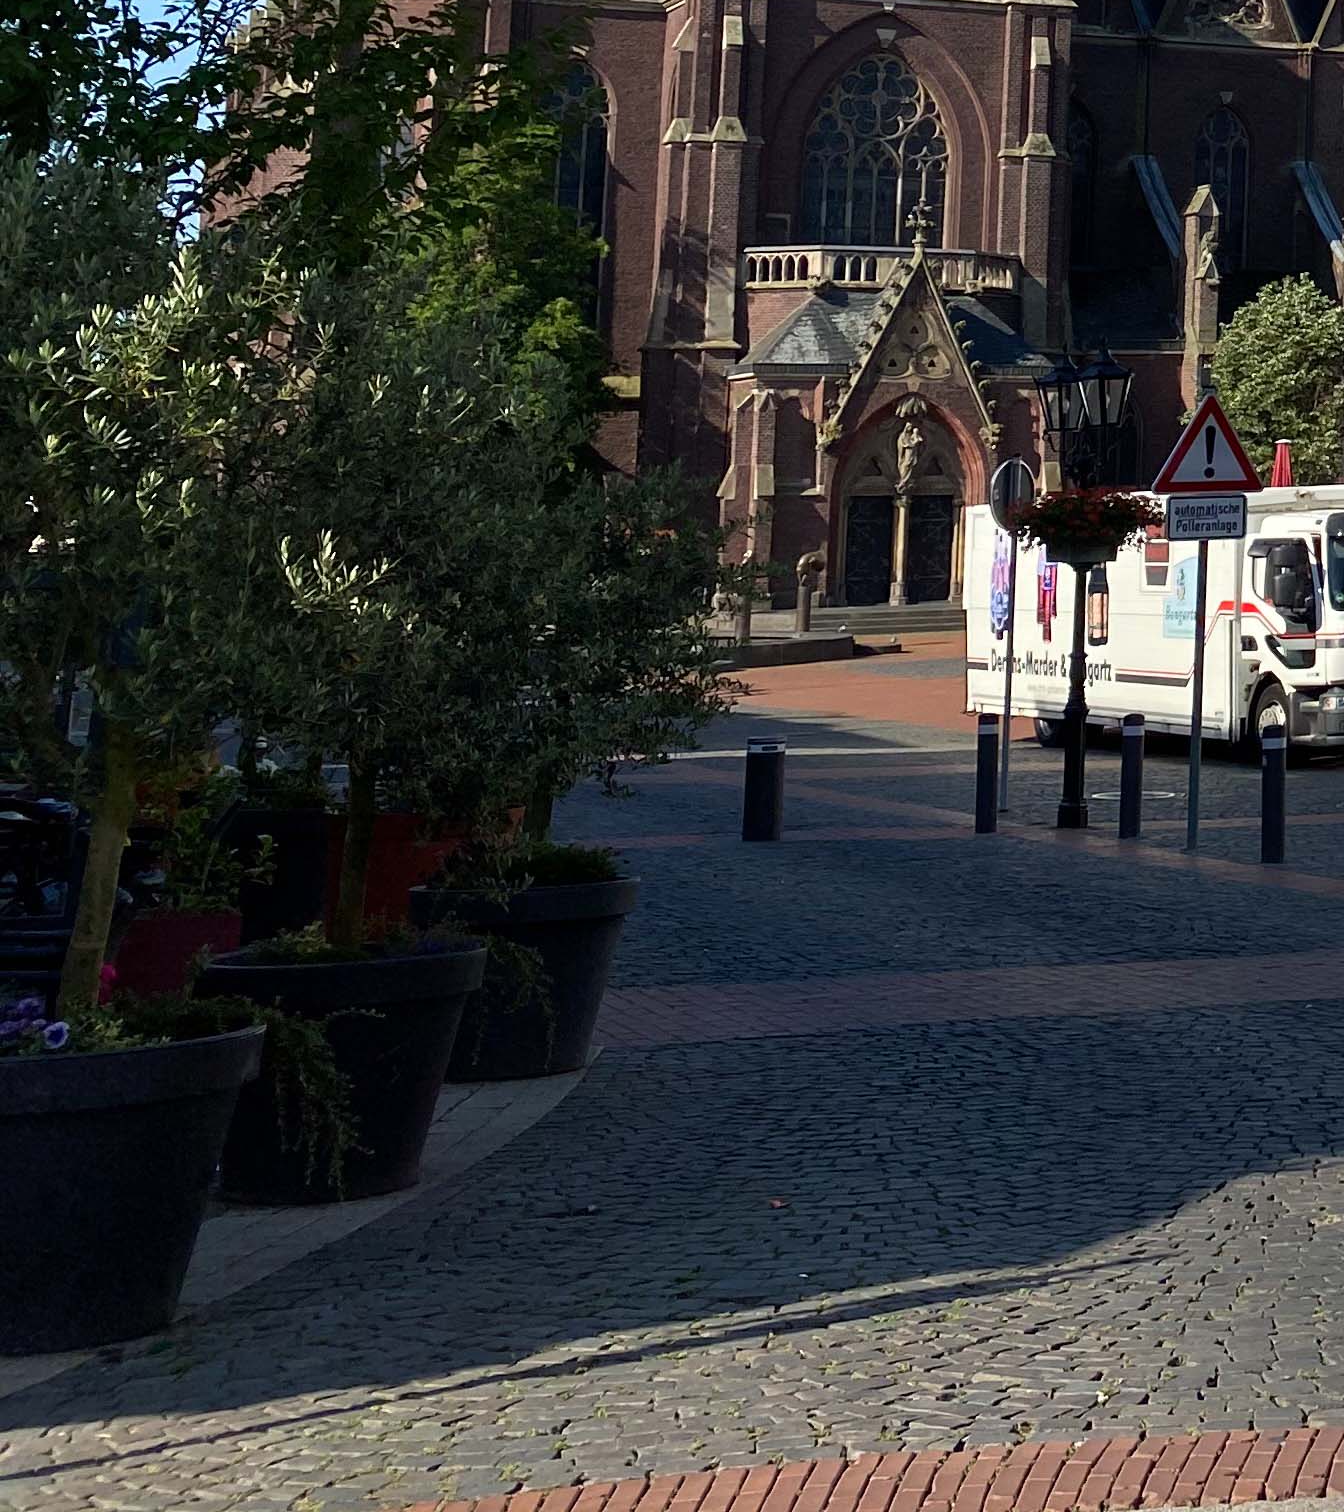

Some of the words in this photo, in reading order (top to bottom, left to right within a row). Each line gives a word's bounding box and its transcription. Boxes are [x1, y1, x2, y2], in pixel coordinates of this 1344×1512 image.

[1174, 504, 1240, 517] automatische
[1175, 520, 1238, 533] Polleranlage
[1060, 653, 1067, 678] &
